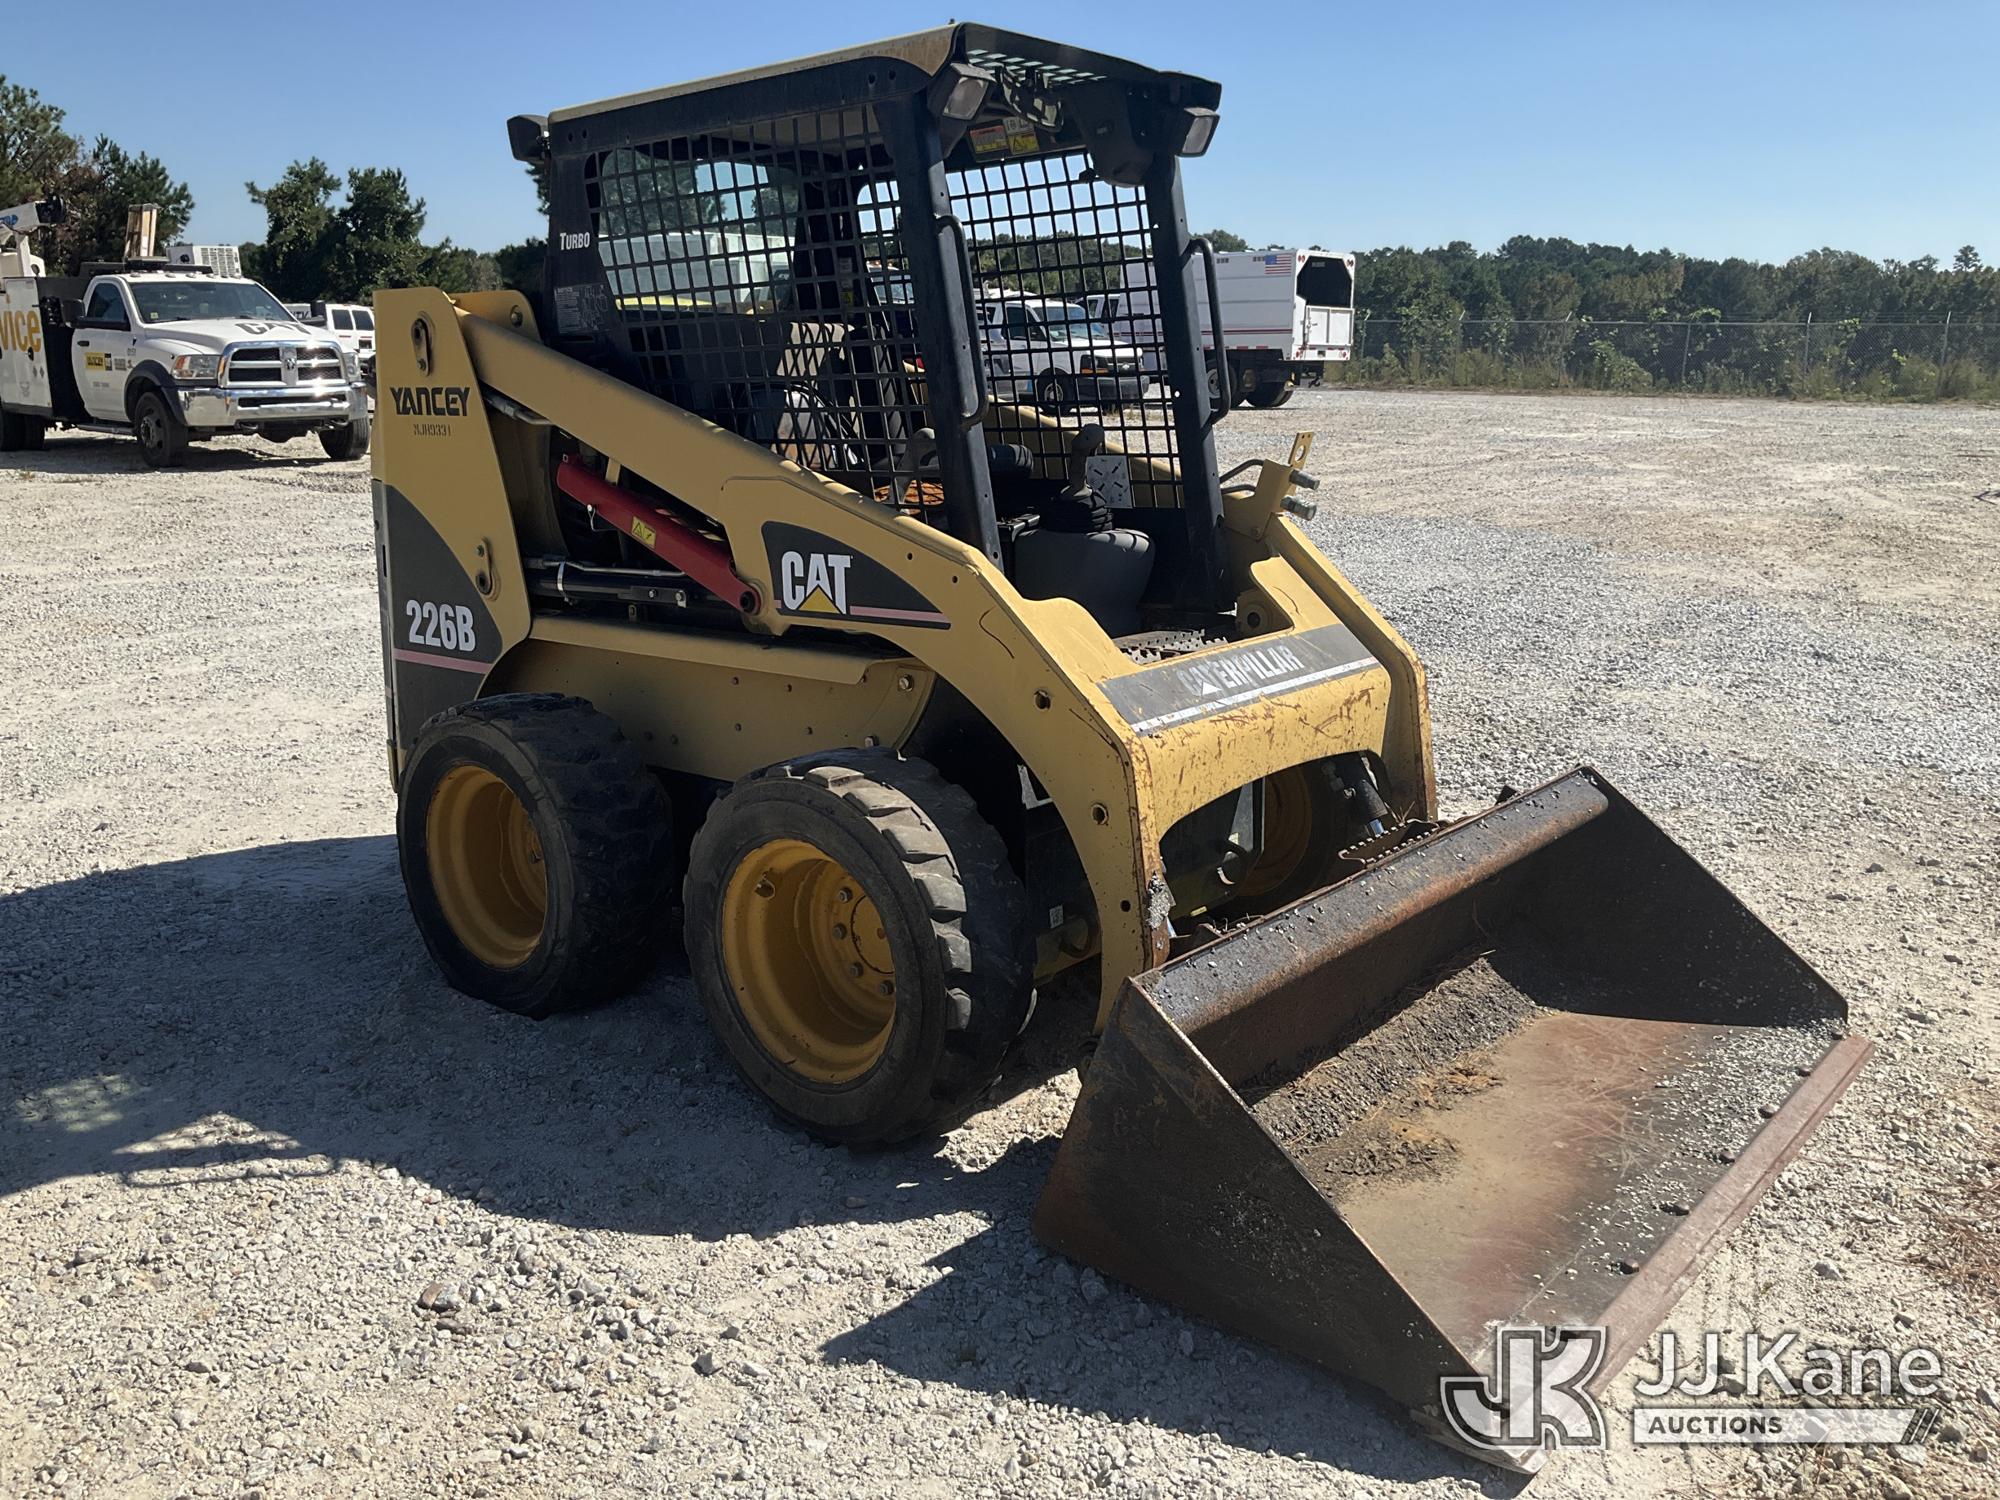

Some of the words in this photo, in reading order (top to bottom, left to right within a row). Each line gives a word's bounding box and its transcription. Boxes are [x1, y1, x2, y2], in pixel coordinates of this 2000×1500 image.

[389, 386, 471, 417] YANCEY
[781, 550, 852, 615] CAT
[406, 599, 476, 652] 226B
[1175, 645, 1306, 697] CATERPILLAR
